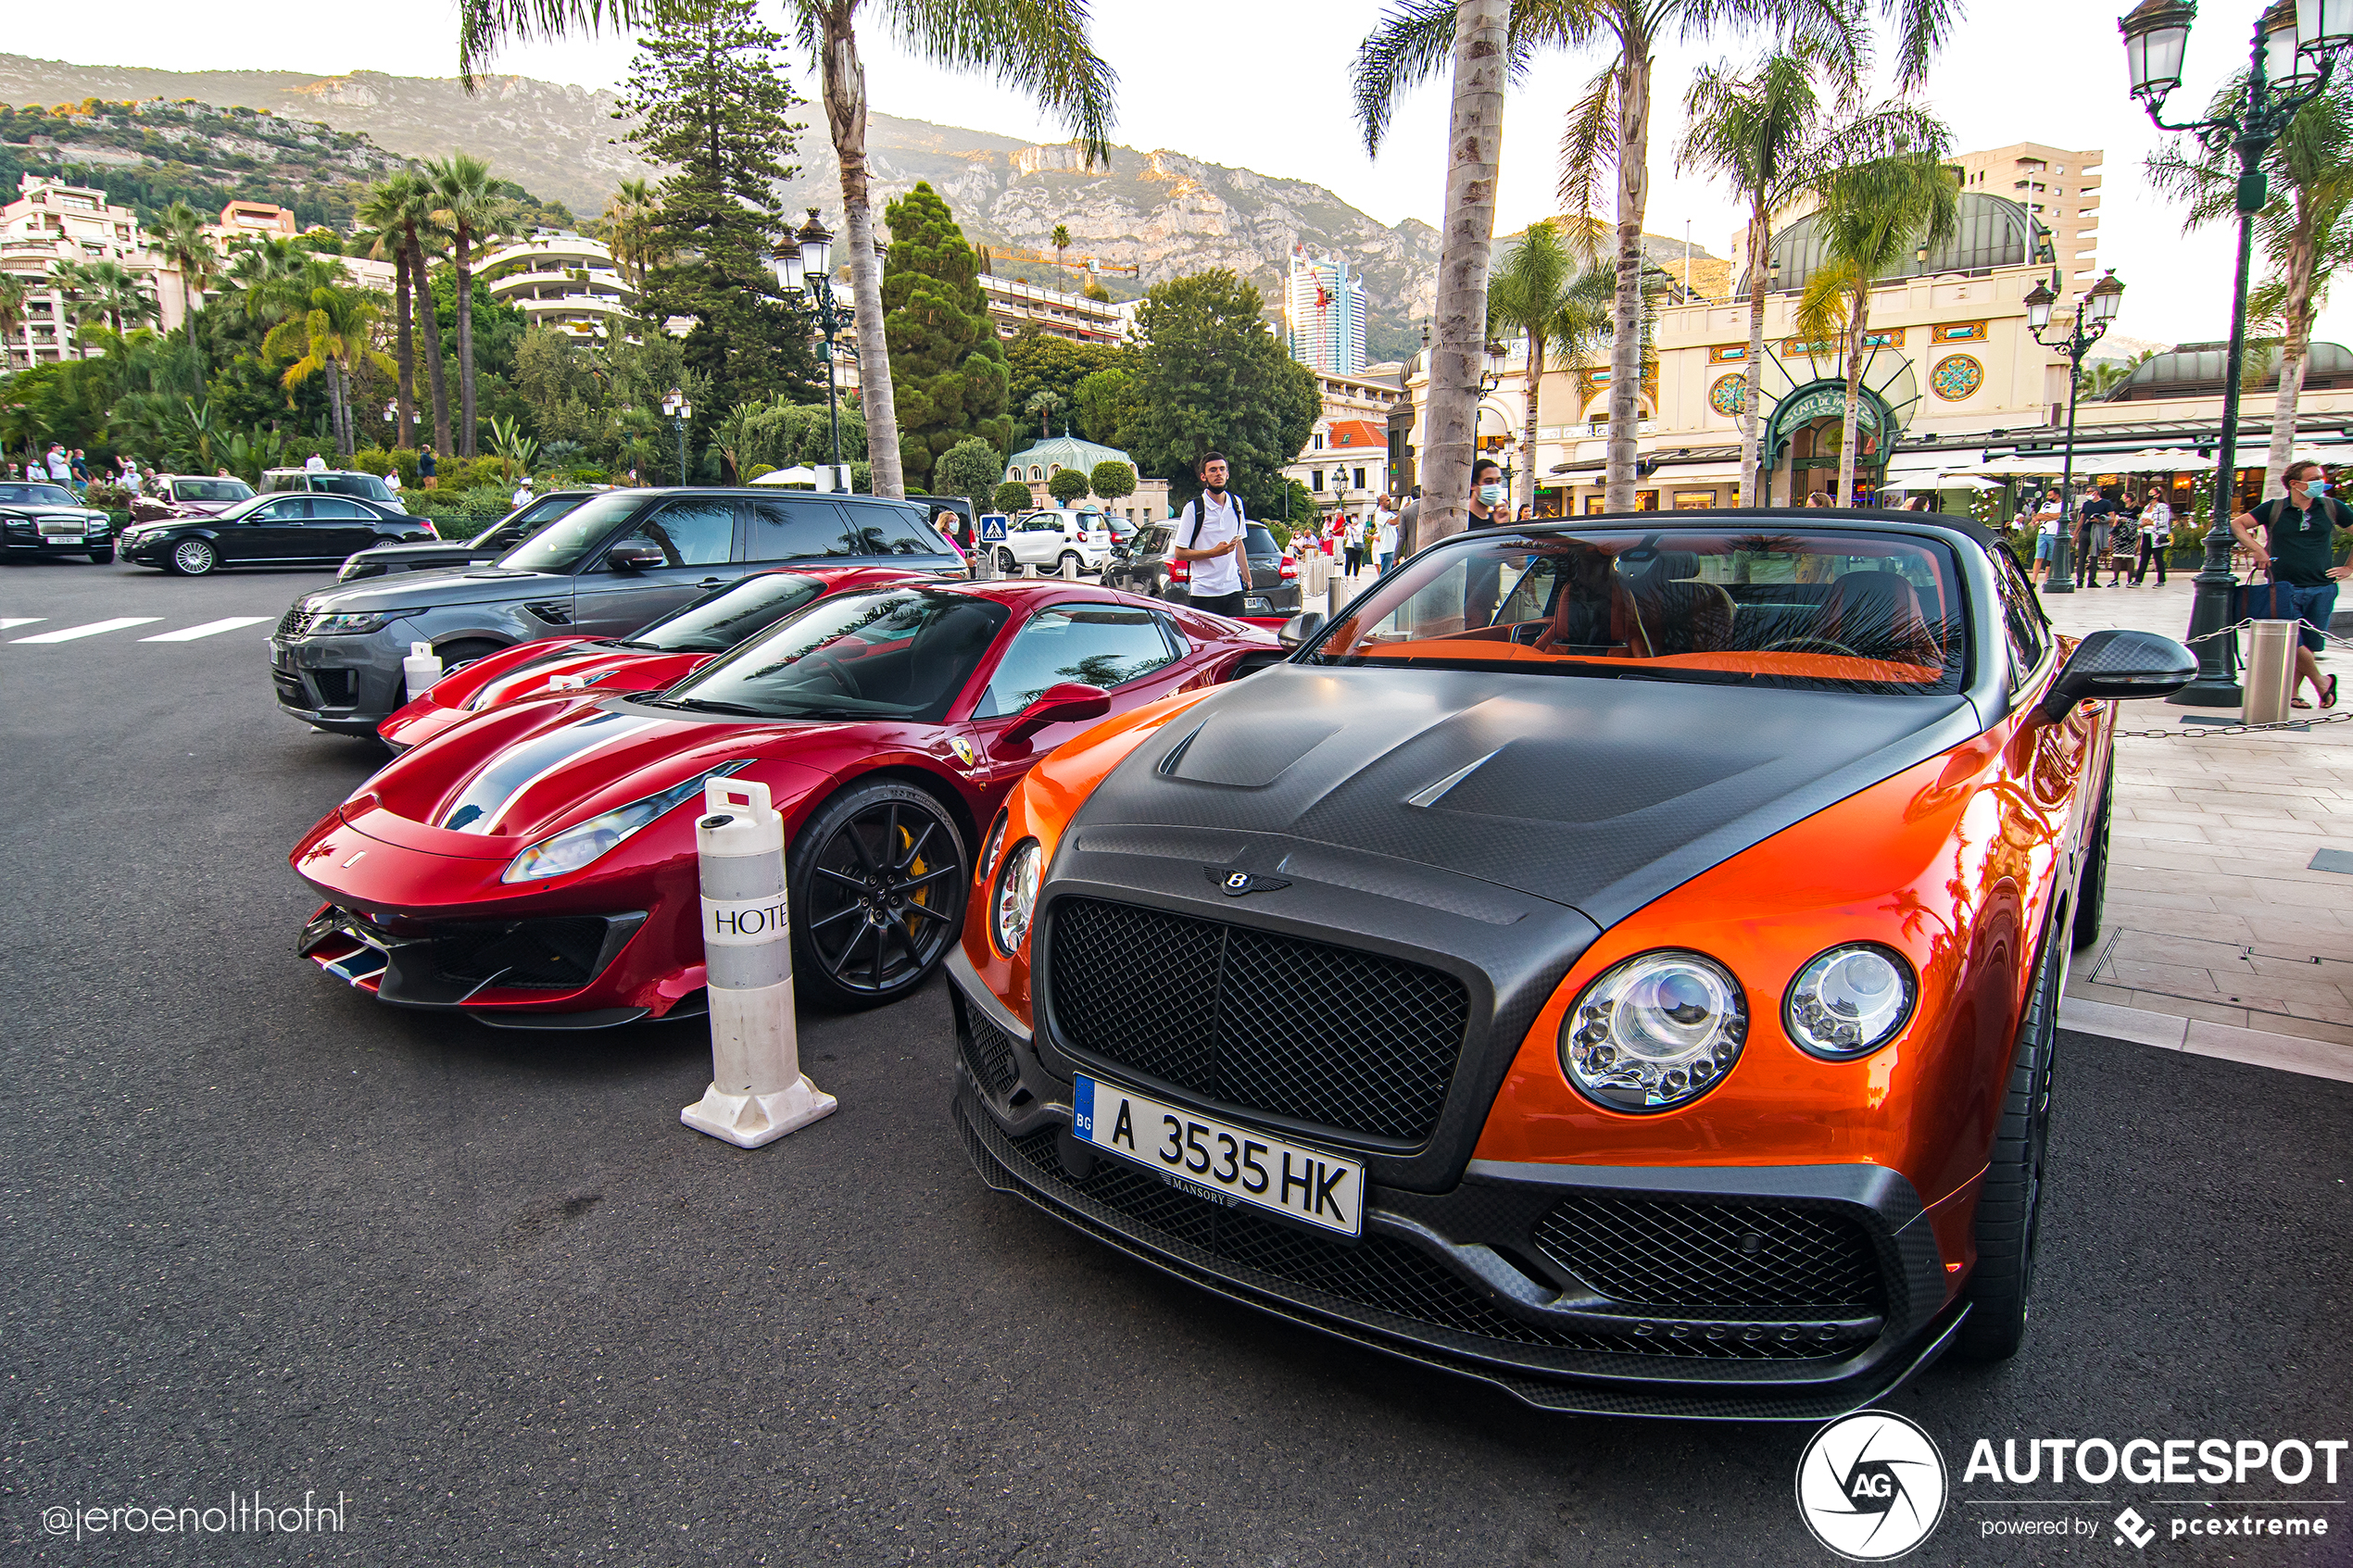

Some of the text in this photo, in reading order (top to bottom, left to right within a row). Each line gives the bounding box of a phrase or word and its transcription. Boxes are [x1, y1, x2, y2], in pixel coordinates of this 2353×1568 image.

[1818, 396, 1831, 407] DE
[1809, 457, 1863, 469] CASIO
[914, 795, 942, 815] MICHELIN
[1227, 872, 1248, 888] B
[715, 901, 789, 935] HOTE
[1076, 1112, 1092, 1131] BG
[1112, 1098, 1348, 1223] A 3535 HK
[1172, 1177, 1226, 1206] MANSORY
